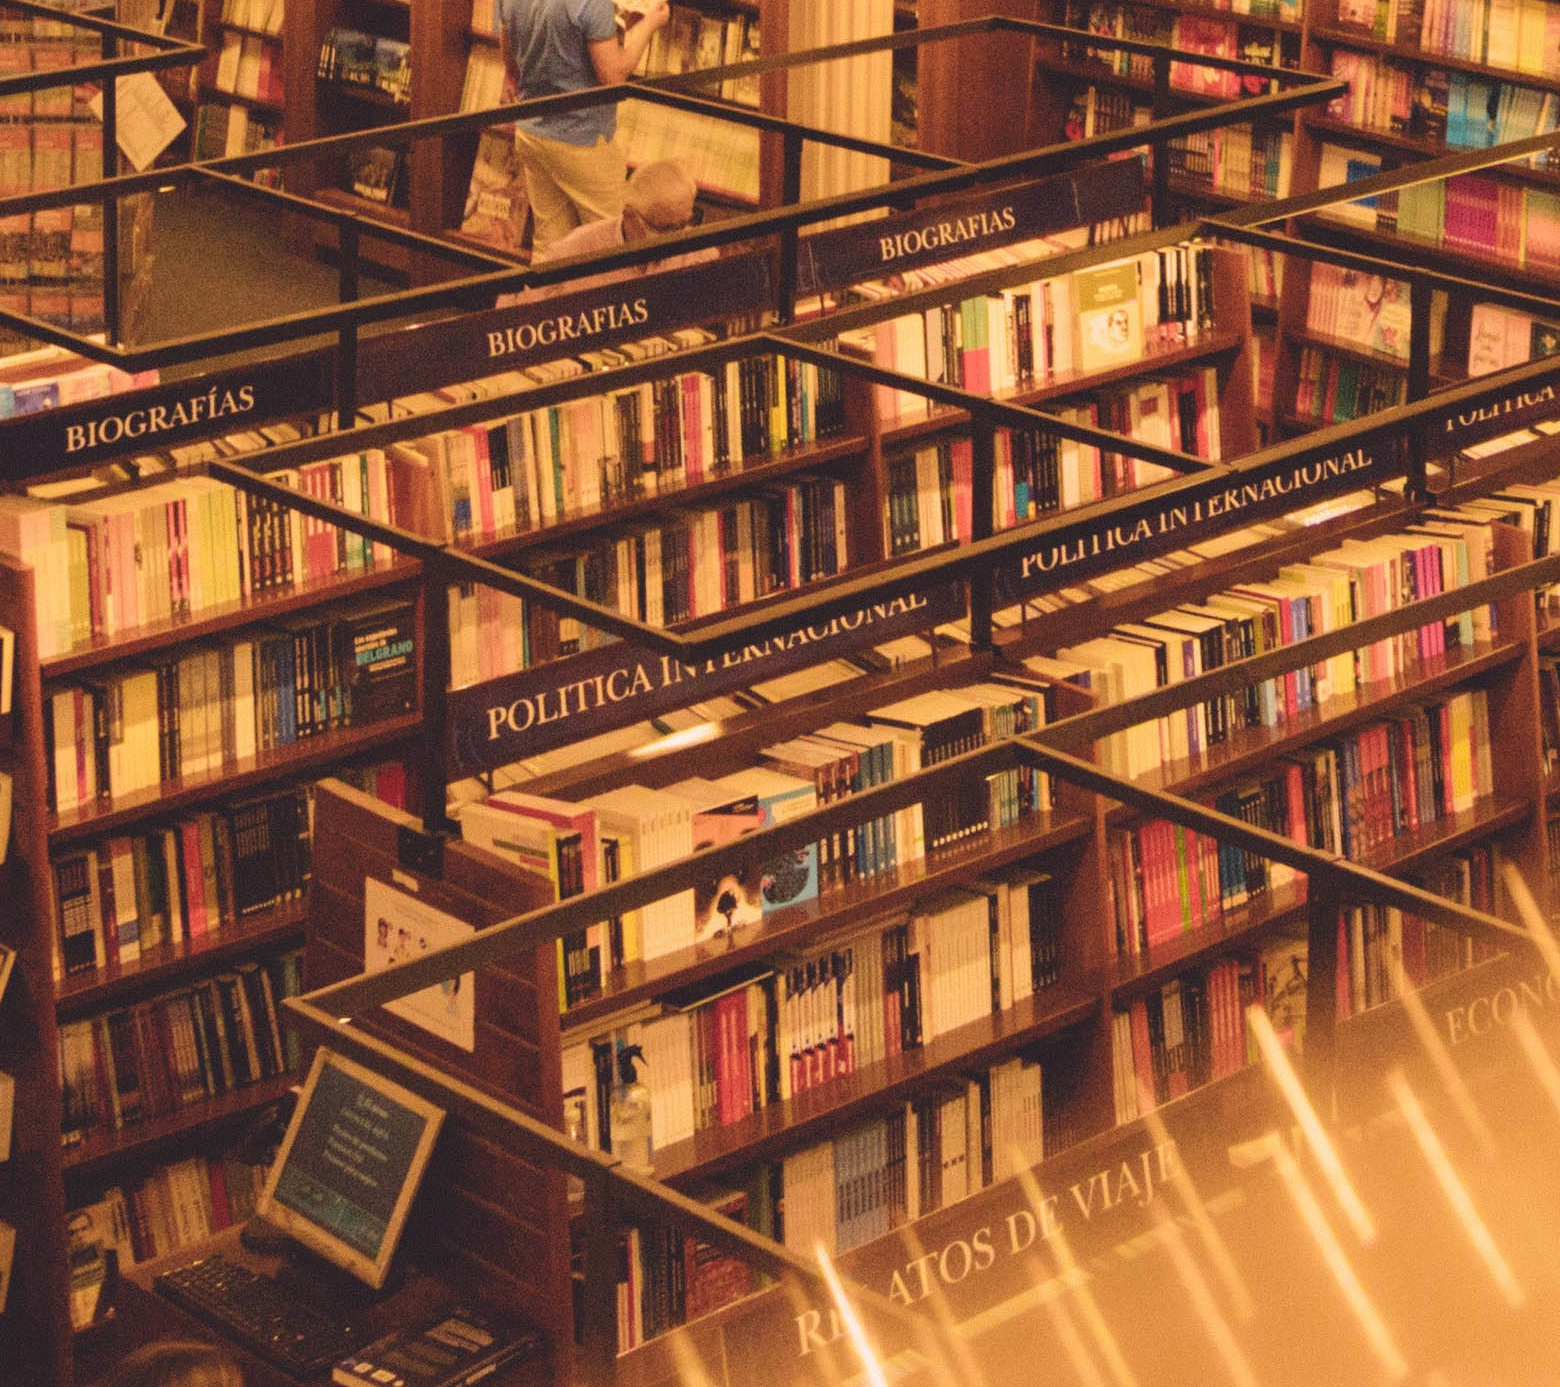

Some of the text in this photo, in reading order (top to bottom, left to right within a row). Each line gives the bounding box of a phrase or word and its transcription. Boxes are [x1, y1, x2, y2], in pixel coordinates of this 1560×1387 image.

[878, 206, 1016, 262] BIOGRAFIAS
[486, 297, 650, 359] BIOGRAFIAS
[64, 382, 255, 455] BIOGRAFÍAS
[355, 639, 413, 667] BELGRANO
[486, 661, 654, 742] POLITICA
[1004, 1195, 1065, 1256] DE
